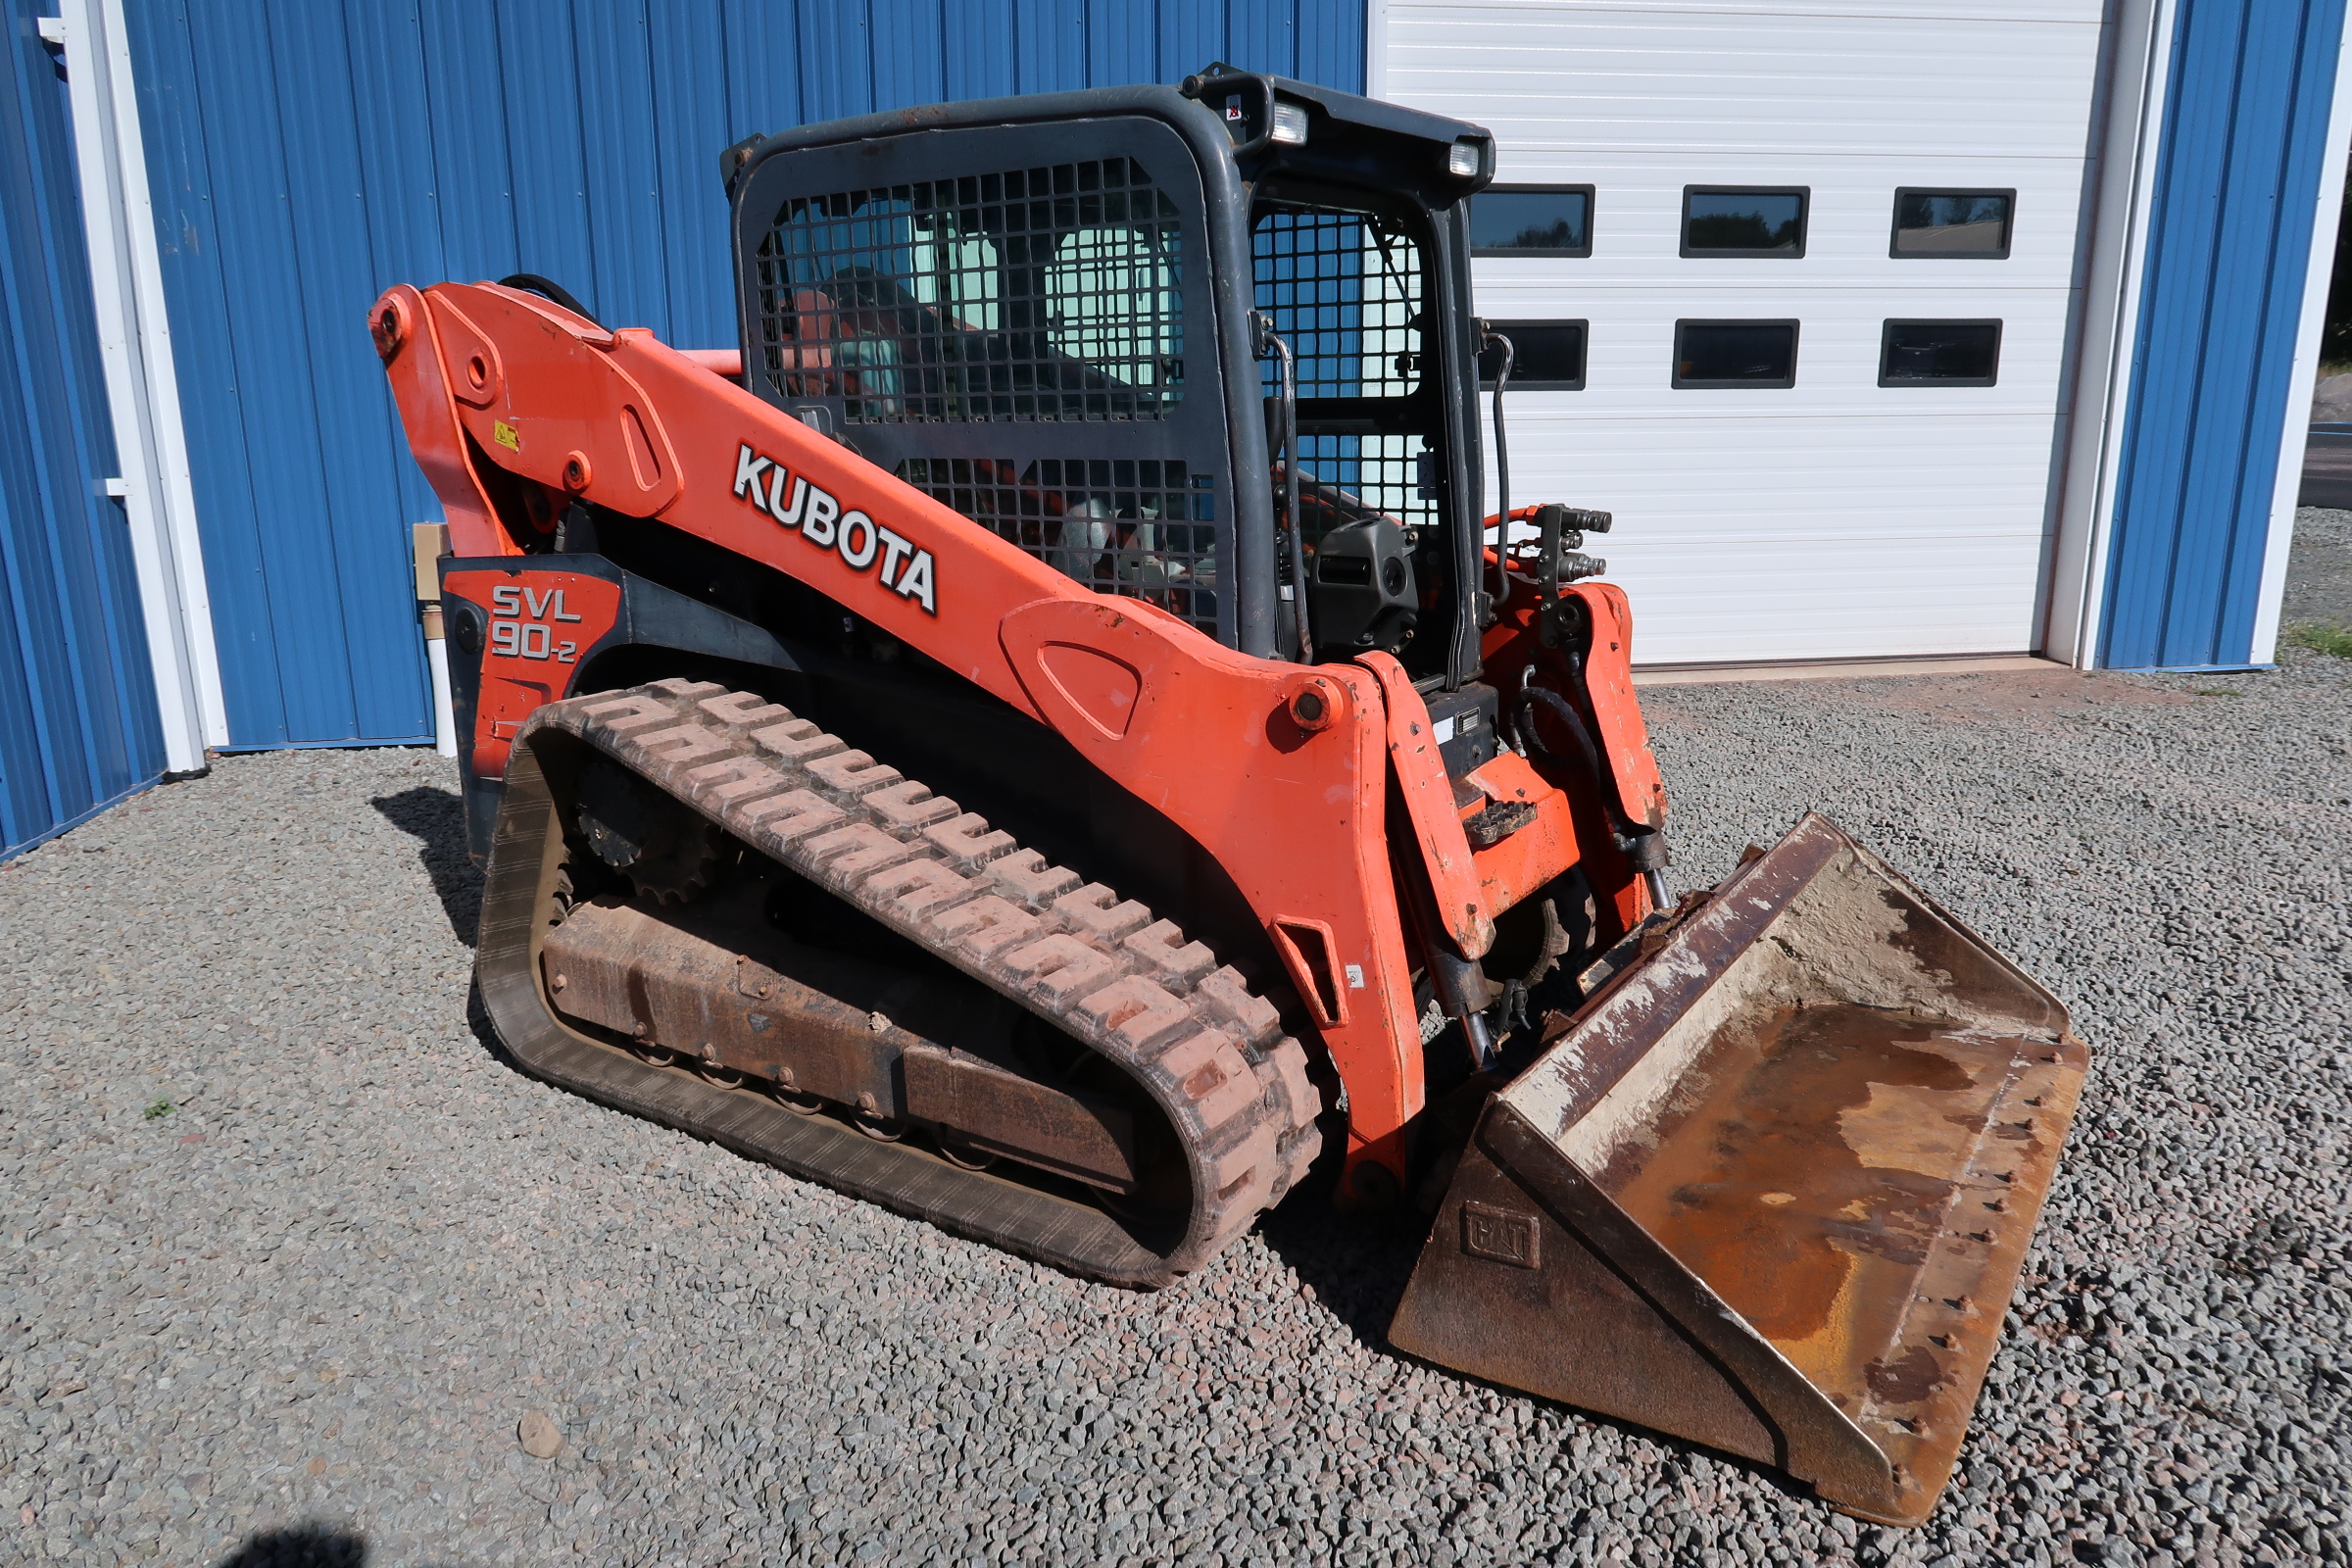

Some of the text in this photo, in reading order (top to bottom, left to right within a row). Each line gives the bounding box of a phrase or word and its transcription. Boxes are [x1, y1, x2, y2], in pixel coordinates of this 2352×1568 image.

[733, 443, 936, 613] KUBOTA
[492, 585, 581, 621] SVL
[491, 621, 576, 662] 90-2
[1469, 1212, 1529, 1261] CAT
